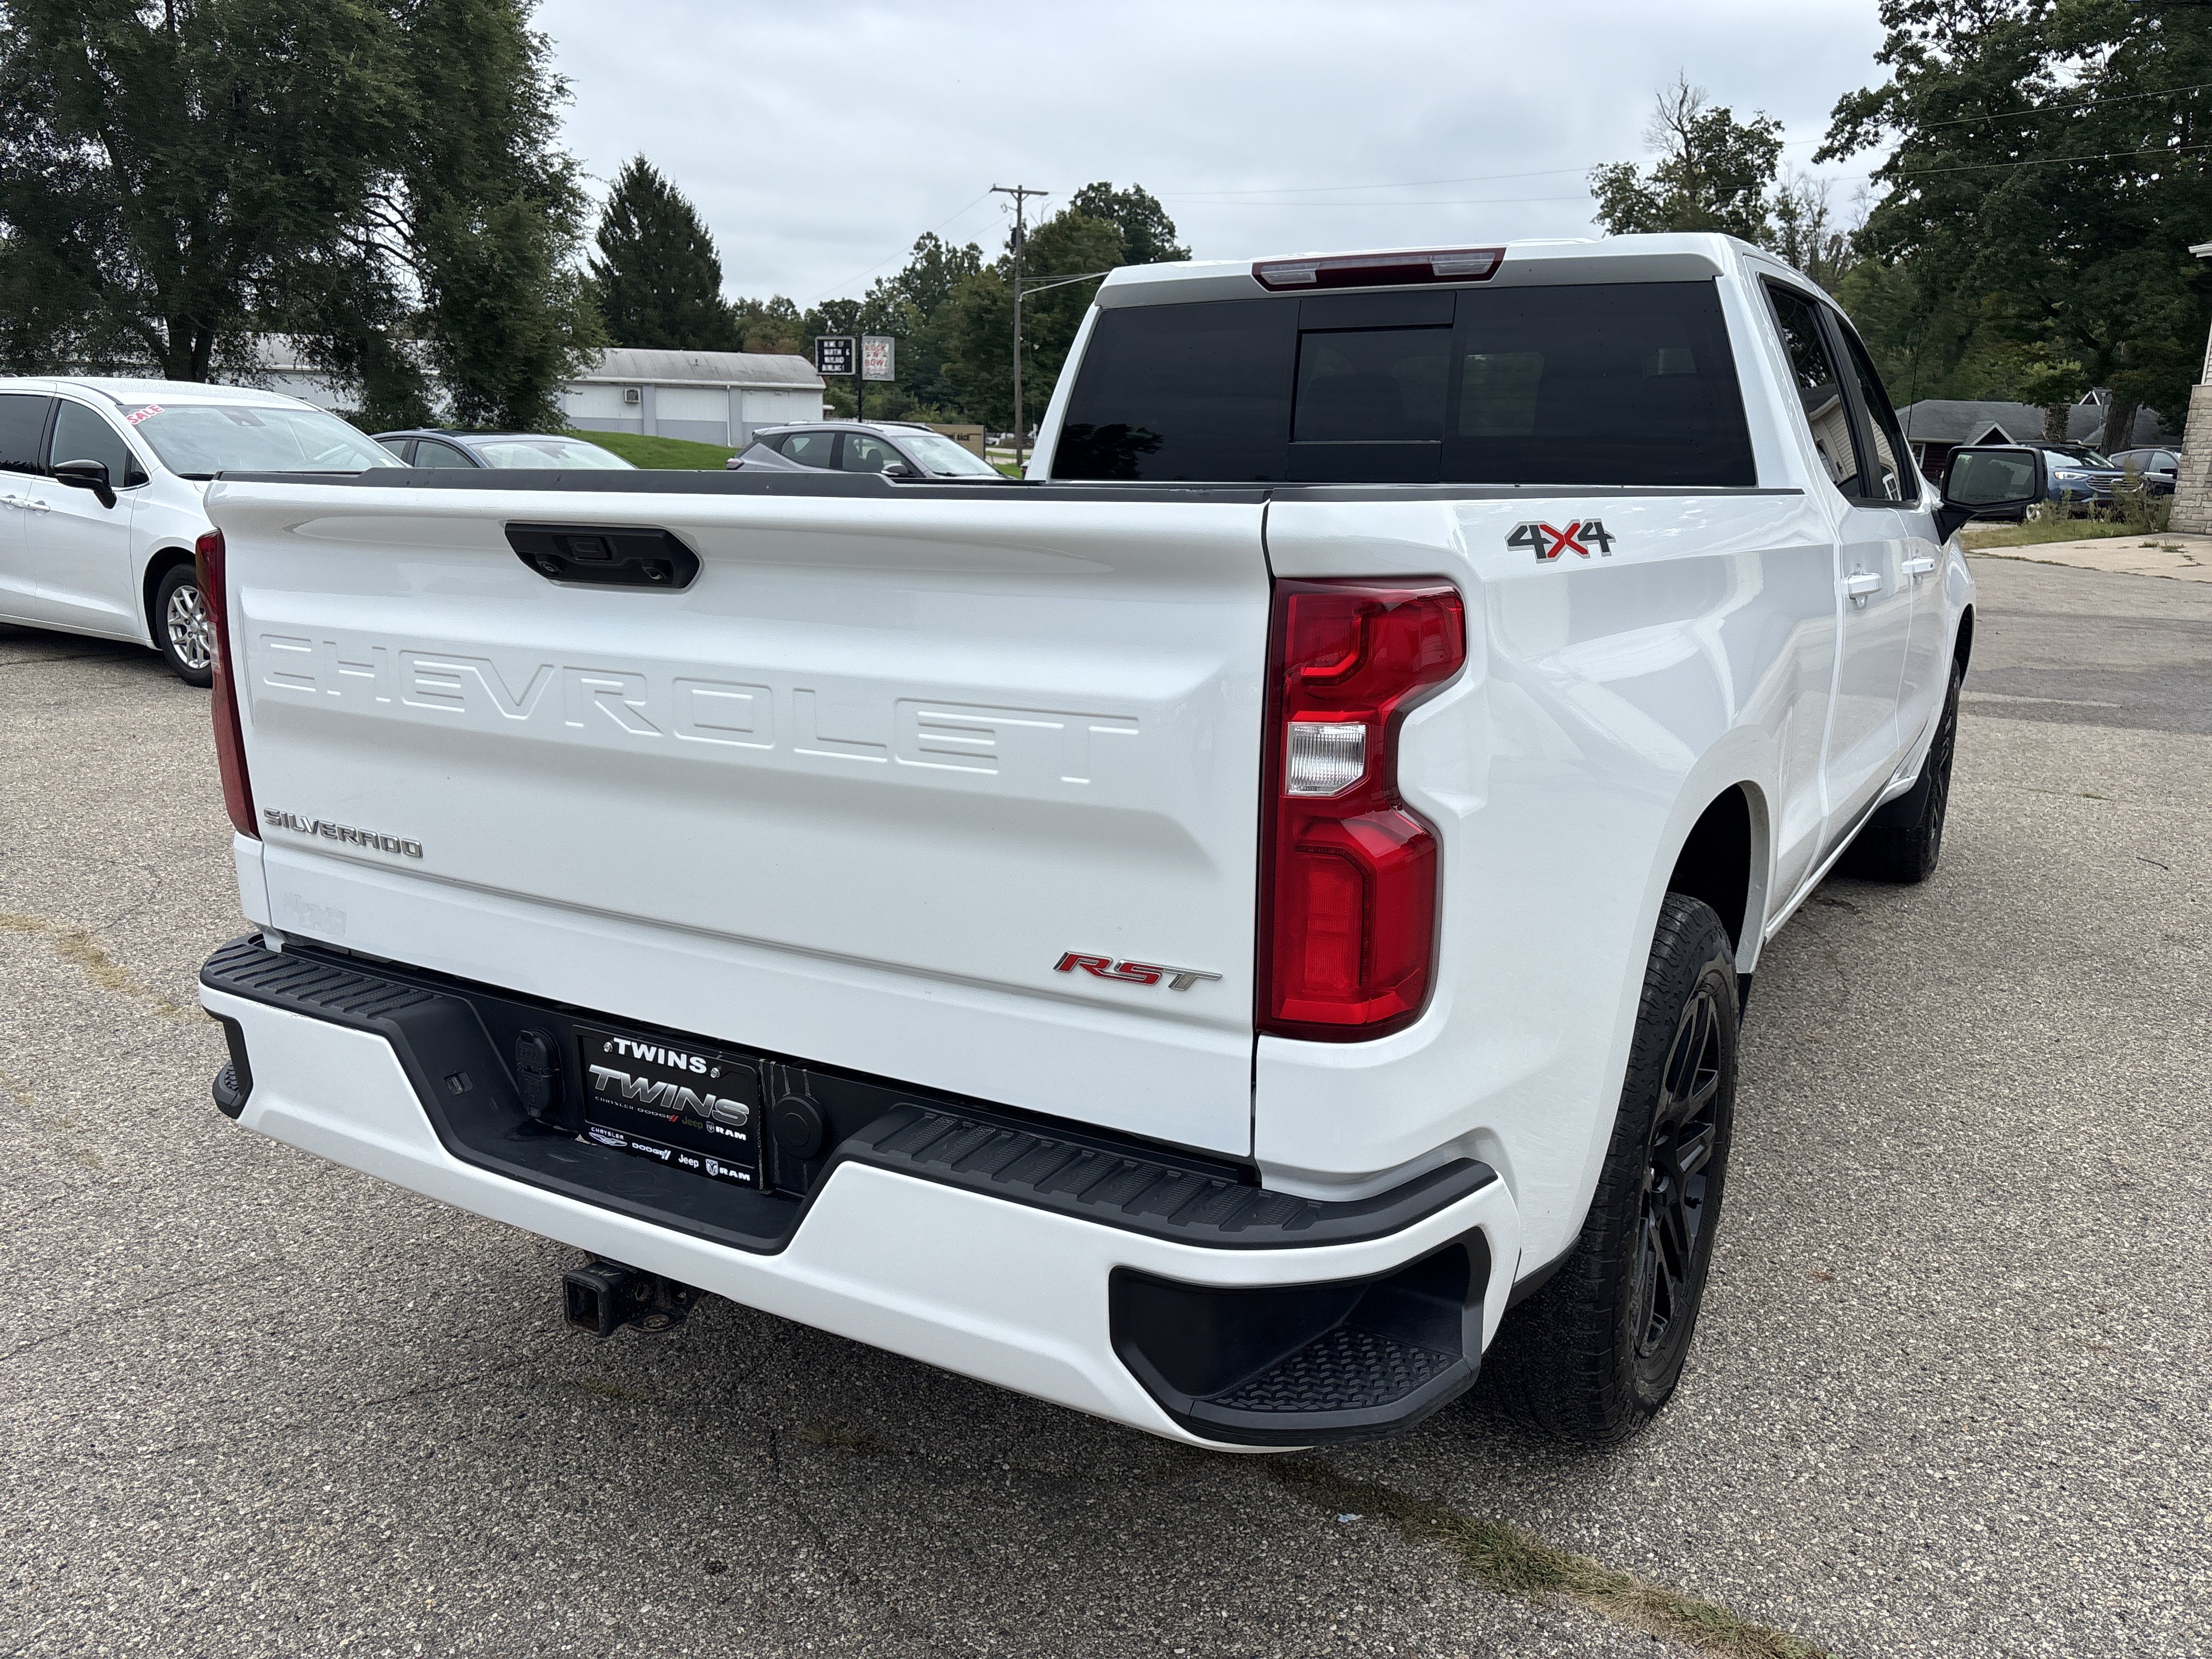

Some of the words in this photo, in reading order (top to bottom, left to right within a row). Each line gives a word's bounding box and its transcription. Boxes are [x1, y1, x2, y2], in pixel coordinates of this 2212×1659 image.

[865, 359, 889, 367] BOWL
[127, 405, 163, 424] SALE
[260, 633, 1139, 783] CHEVROLET
[263, 808, 423, 858] SILVERADO
[1053, 951, 1222, 991] RST
[613, 1037, 707, 1074] TWINS
[589, 1064, 749, 1126] TWINS
[595, 1096, 634, 1110] CHRYSLER
[637, 1107, 674, 1120] DODGE
[681, 1116, 703, 1130] Jeep
[715, 1126, 747, 1141] RAM
[591, 1126, 624, 1140] CHRYSLER
[632, 1142, 667, 1158] DODGE
[678, 1154, 699, 1169] Jeep
[719, 1167, 751, 1181] RAM
